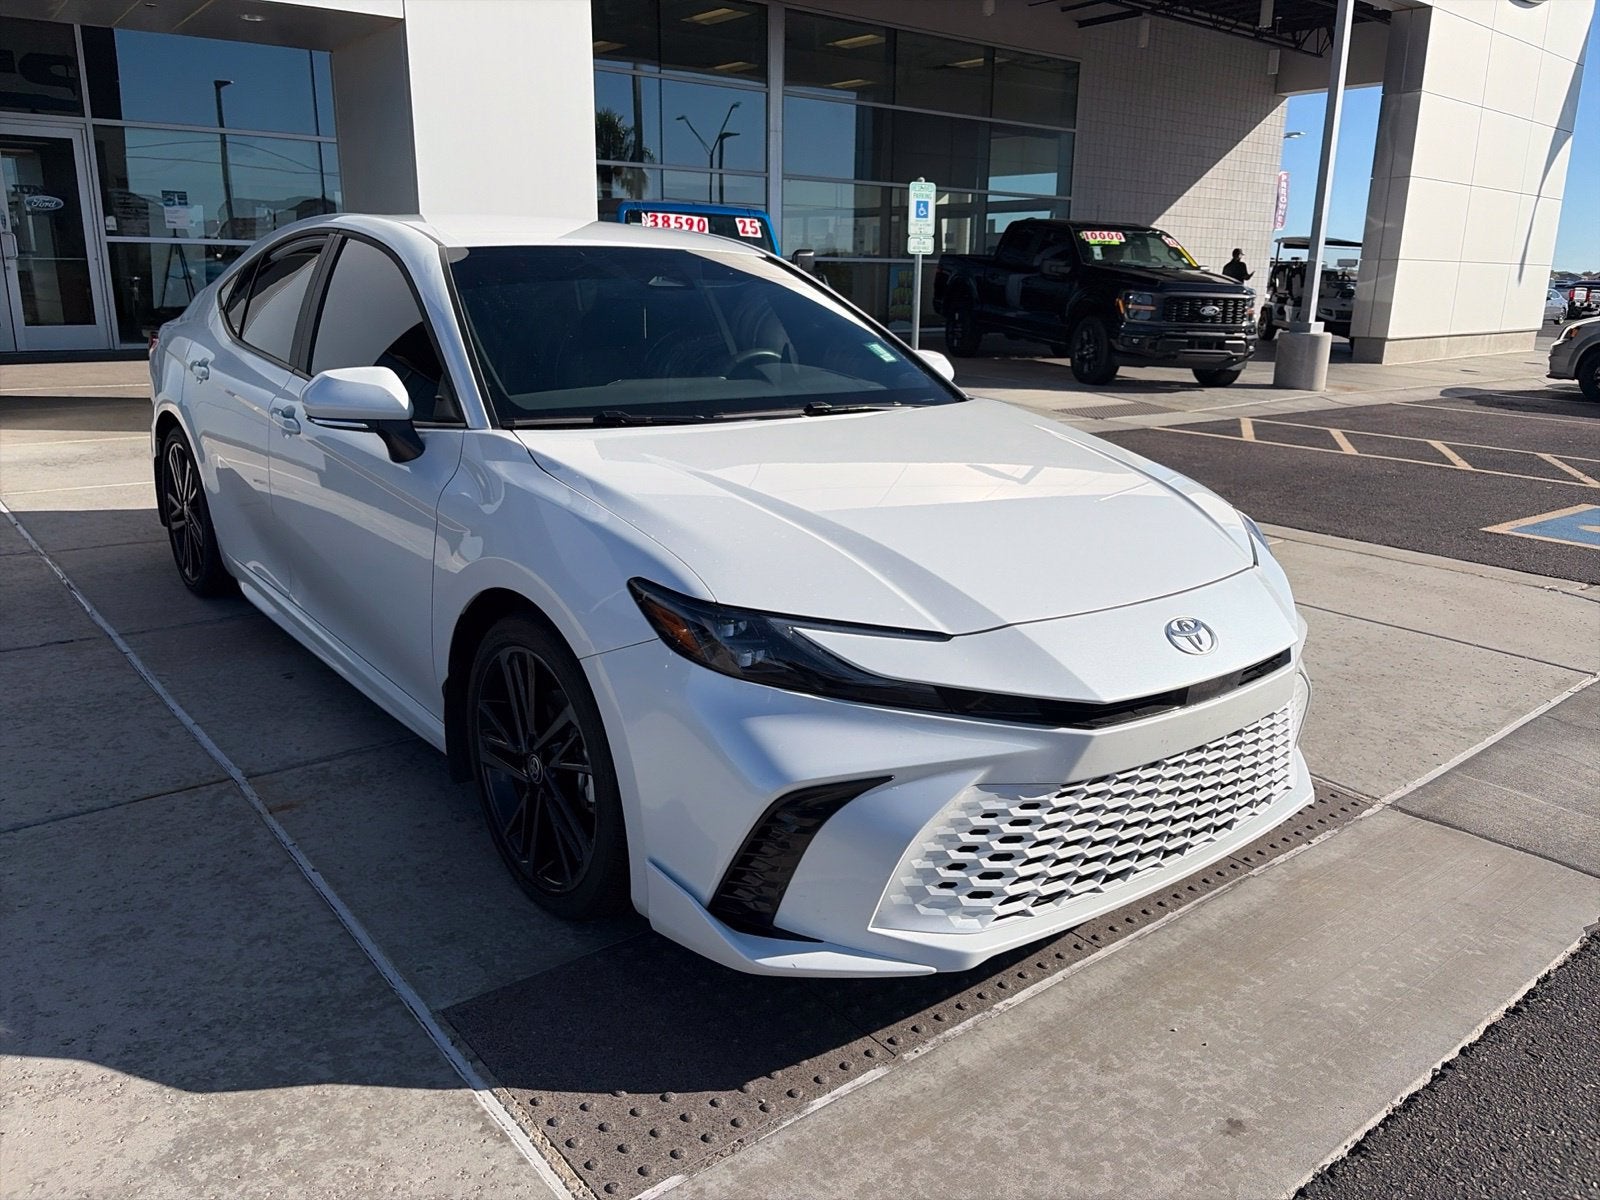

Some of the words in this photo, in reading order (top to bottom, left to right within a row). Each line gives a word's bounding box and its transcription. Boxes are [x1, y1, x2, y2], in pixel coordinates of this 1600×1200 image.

[31, 197, 57, 208] Ford
[1275, 173, 1288, 228] PREOWNED
[649, 213, 706, 233] 38590
[738, 219, 759, 235] 25
